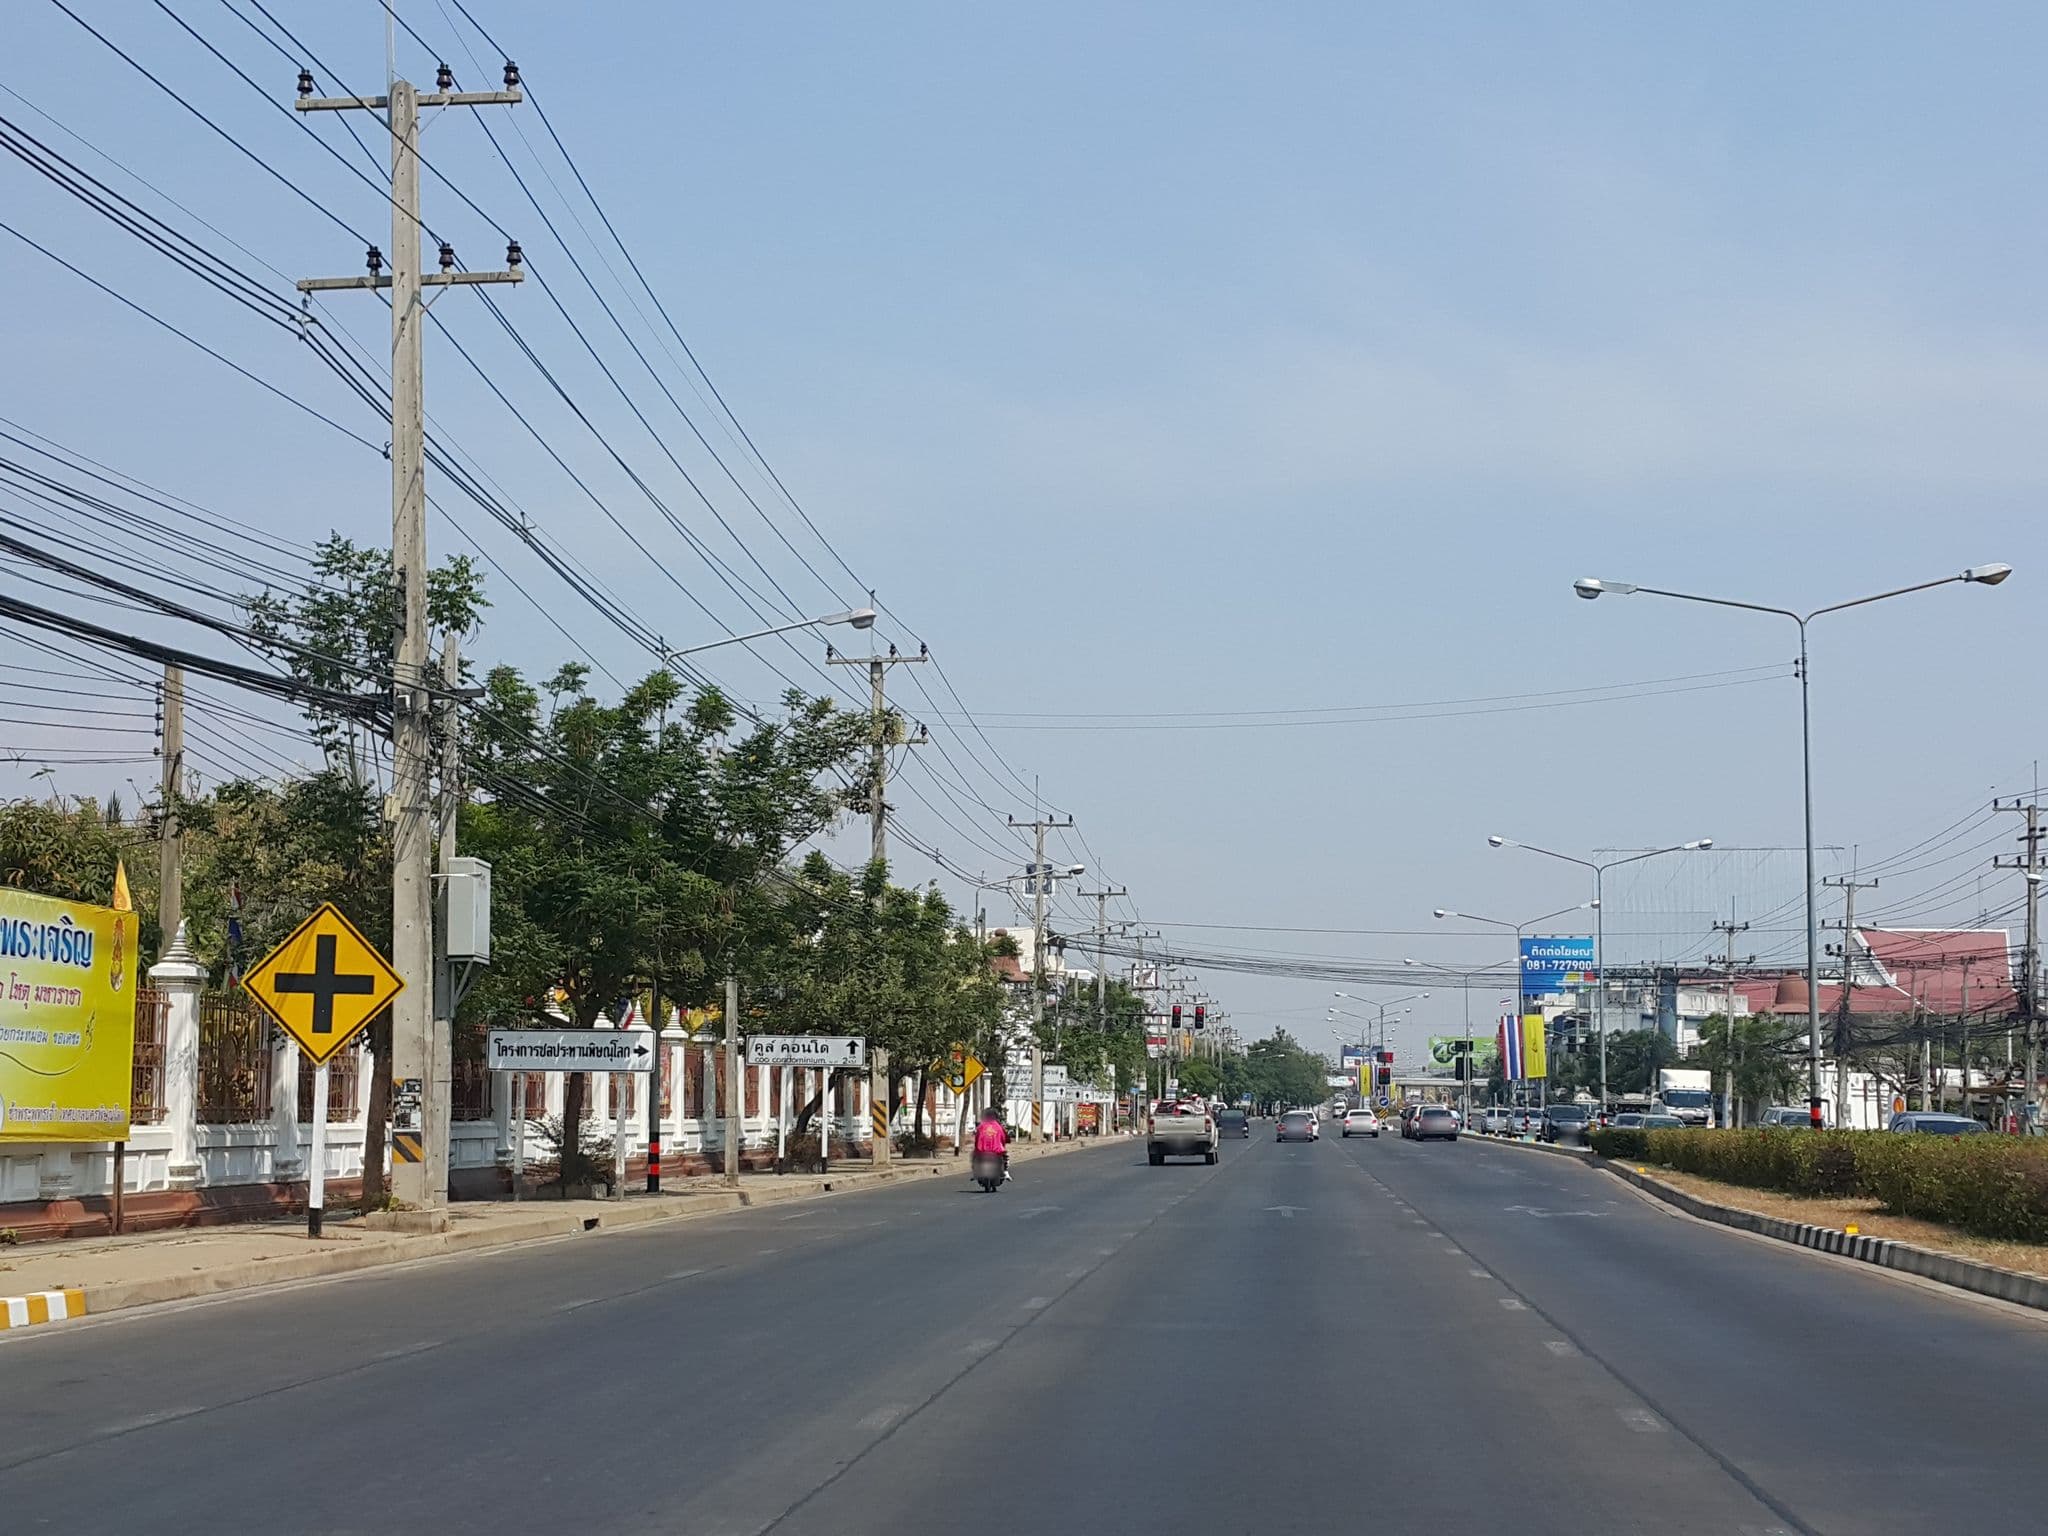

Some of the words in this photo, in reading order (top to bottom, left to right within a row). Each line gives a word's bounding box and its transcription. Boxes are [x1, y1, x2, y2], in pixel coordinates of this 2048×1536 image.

[0, 915, 93, 968] พระเจริญ
[1526, 960, 1592, 971] 081-727900
[34, 985, 82, 1007] มหาราชา
[494, 1038, 630, 1062] โครงการชลประทานพิษณุโลก
[781, 1040, 829, 1054] คอนโด
